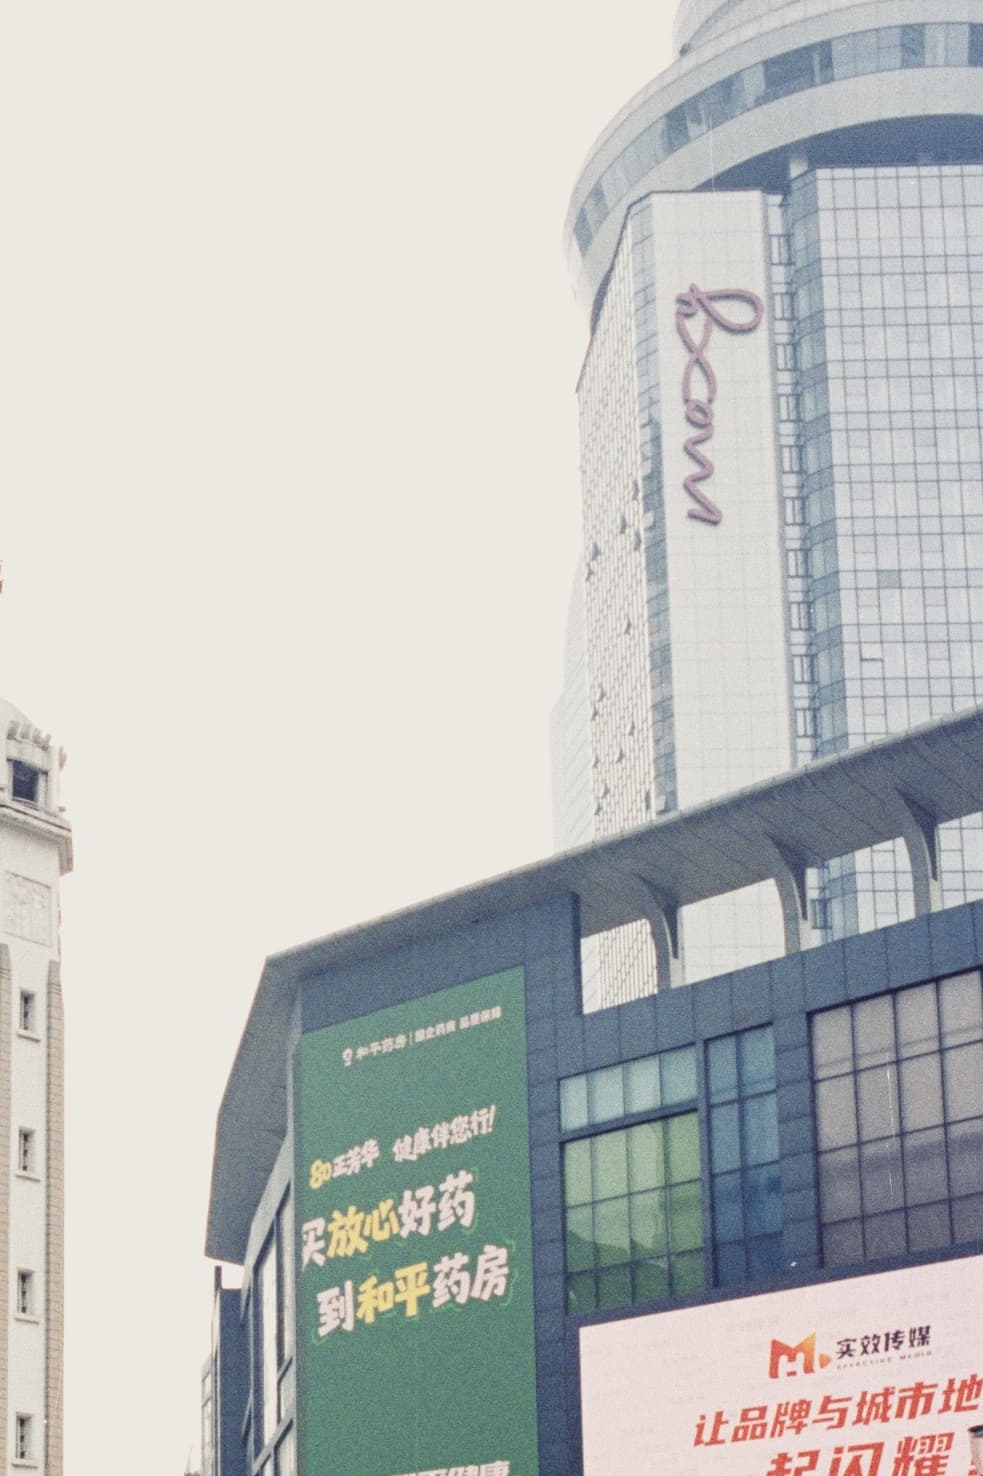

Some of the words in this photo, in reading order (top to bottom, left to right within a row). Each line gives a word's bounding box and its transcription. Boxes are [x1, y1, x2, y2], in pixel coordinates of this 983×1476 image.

[393, 1104, 496, 1162] 健康伴您行!
[302, 1170, 475, 1272] 买放心好药
[318, 1245, 509, 1337] 到和平药房
[836, 1325, 931, 1360] 实效传媒
[694, 1374, 983, 1448] 让品牌与城市地
